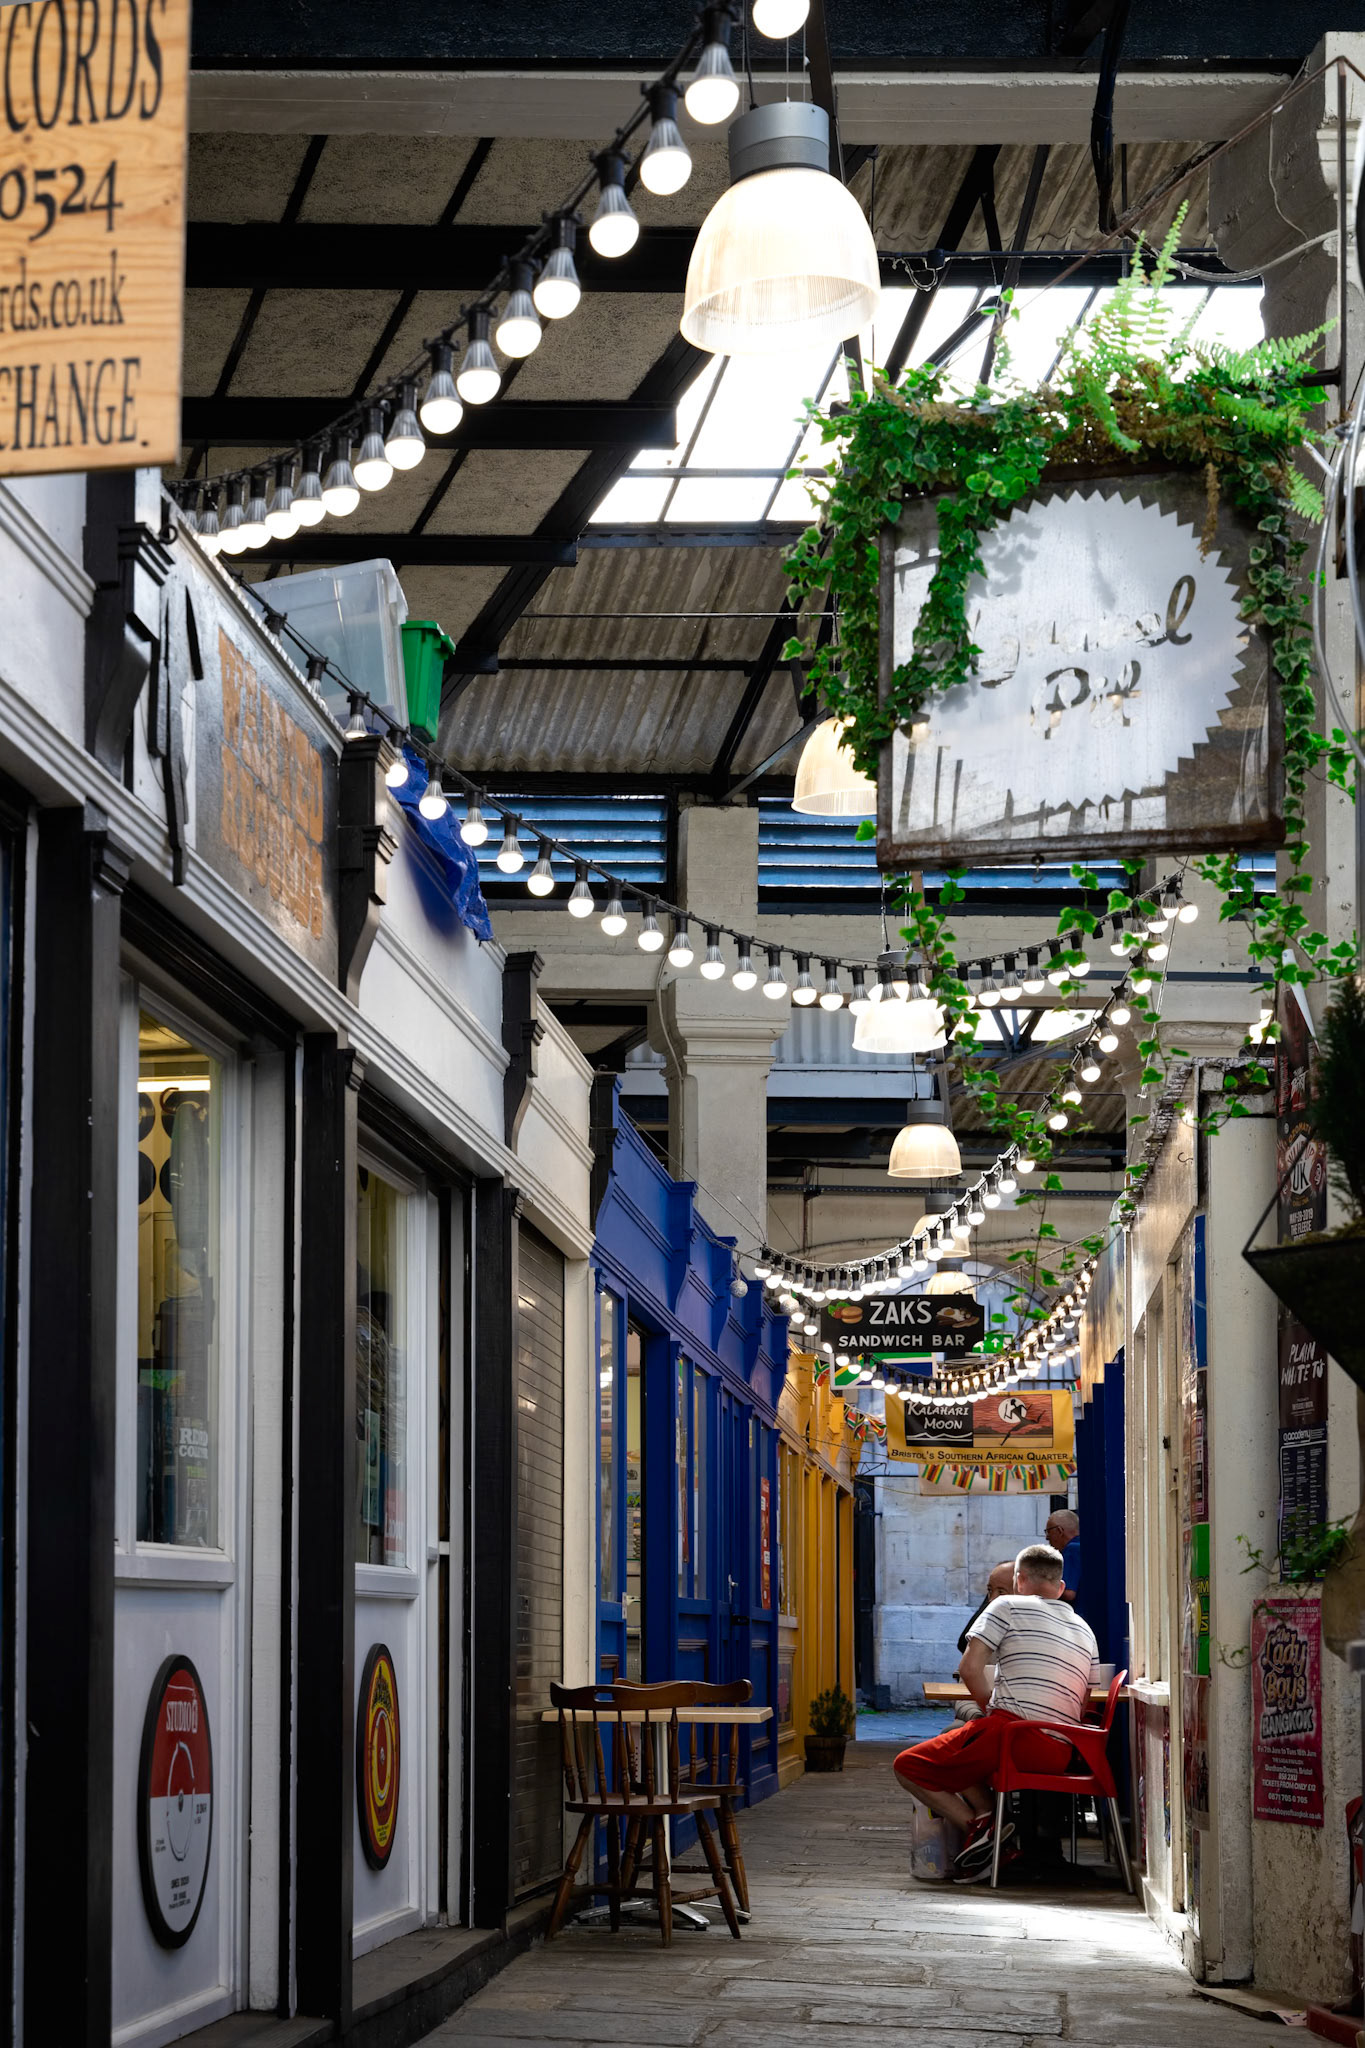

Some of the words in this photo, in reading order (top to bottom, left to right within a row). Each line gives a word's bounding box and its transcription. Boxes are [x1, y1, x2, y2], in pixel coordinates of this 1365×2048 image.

[1293, 1162, 1309, 1191] UK
[1298, 1220, 1312, 1233] FLEECE
[869, 1298, 932, 1325] ZAK'S
[839, 1335, 923, 1347] SANDWICH
[932, 1334, 965, 1346] BAR
[1289, 1341, 1316, 1363] PLAIN
[1281, 1364, 1311, 1386] WHITE
[907, 1400, 969, 1416] KALAHARI
[924, 1417, 963, 1430] MOON
[891, 1449, 934, 1460] BRISTOL'S
[937, 1450, 983, 1461] SOUTHERN
[985, 1451, 1023, 1461] AFRICAN
[1026, 1452, 1068, 1461] QUARTER
[1262, 1633, 1306, 1677] Lady
[1264, 1671, 1306, 1709] Boys
[166, 1701, 191, 1732] STUDIO
[1263, 1709, 1312, 1736] BANGKOK
[1262, 1779, 1280, 1787] TICKETS
[1280, 1781, 1294, 1789] FROM
